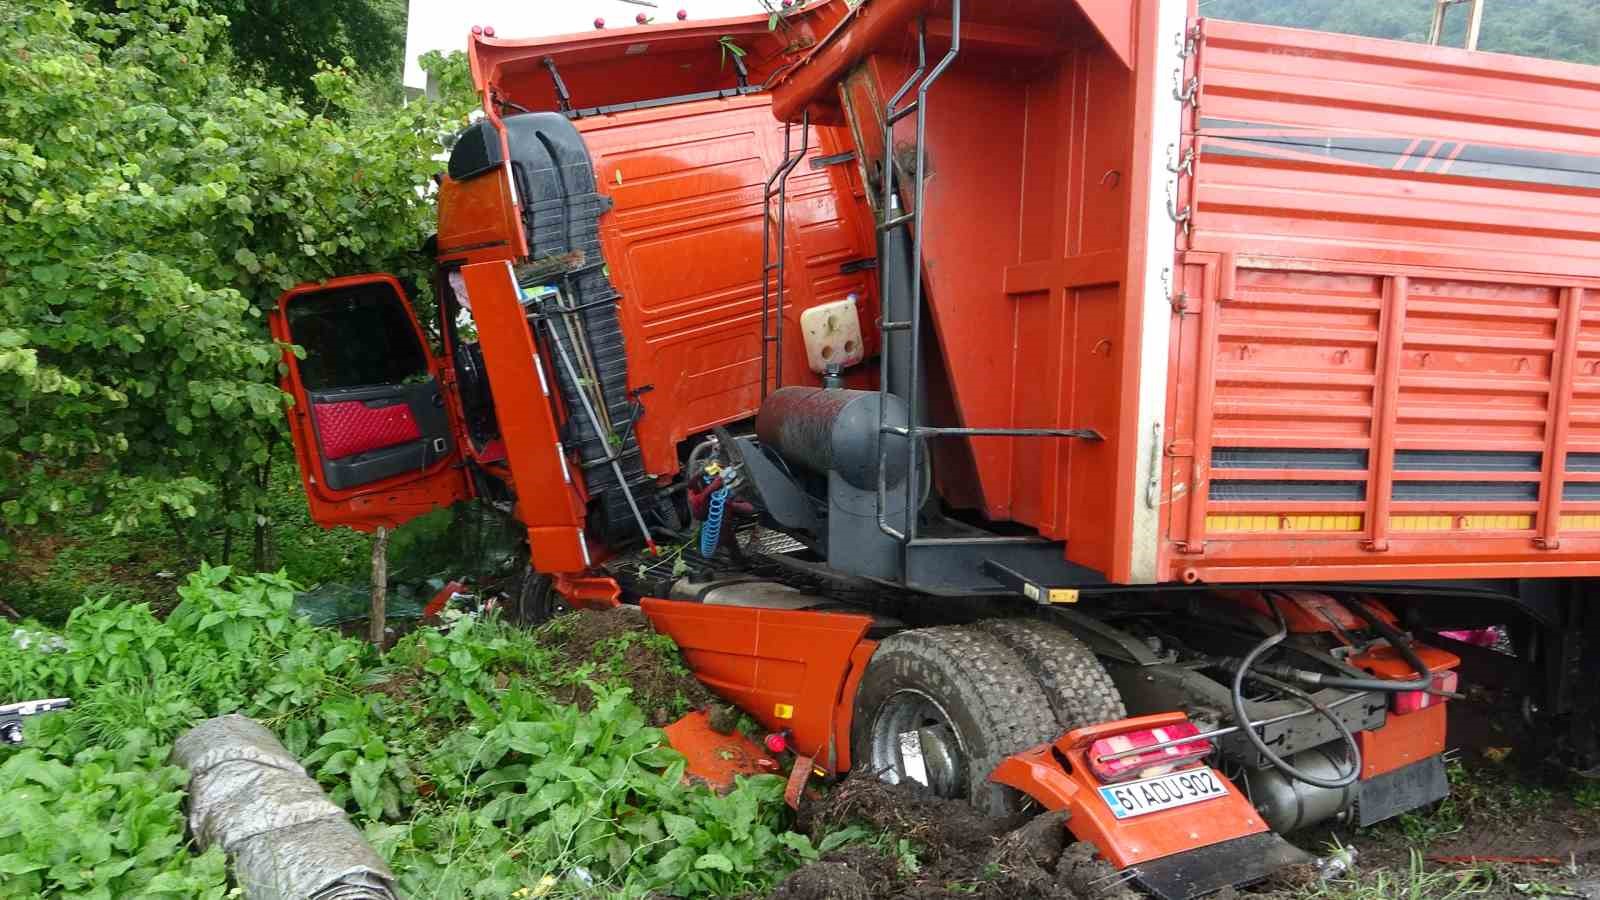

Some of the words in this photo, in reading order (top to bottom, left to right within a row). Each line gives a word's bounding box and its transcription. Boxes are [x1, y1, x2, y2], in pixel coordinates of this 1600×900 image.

[1115, 787, 1143, 810] 61
[1140, 778, 1184, 806] ADU
[1179, 772, 1221, 796] 902
